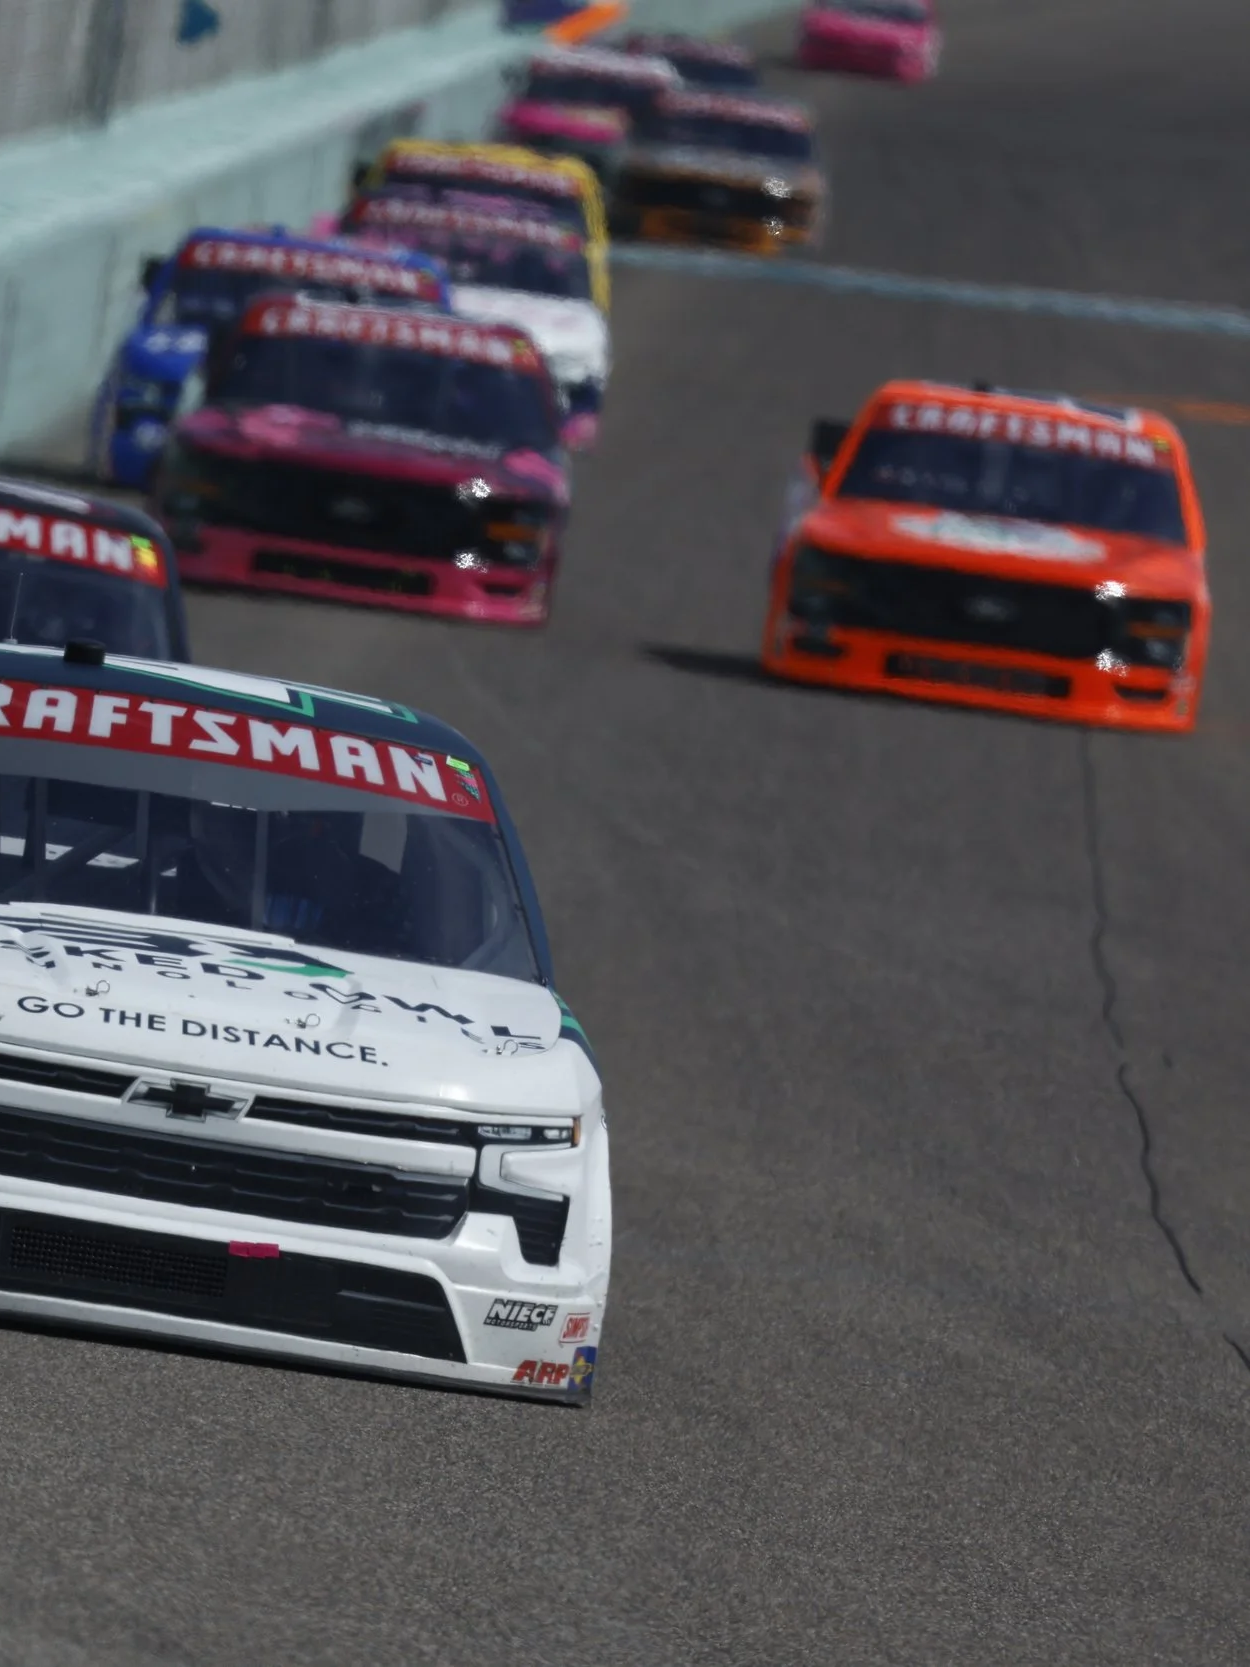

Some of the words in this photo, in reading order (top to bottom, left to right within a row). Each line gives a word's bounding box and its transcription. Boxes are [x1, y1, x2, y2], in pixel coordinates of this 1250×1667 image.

[890, 403, 1156, 467] CRAFTSMAN
[16, 994, 86, 1019] GO
[98, 1007, 167, 1033] THE
[181, 1018, 389, 1067] DISTANCE.
[308, 981, 543, 1041] OWL
[511, 1359, 571, 1385] ARP
